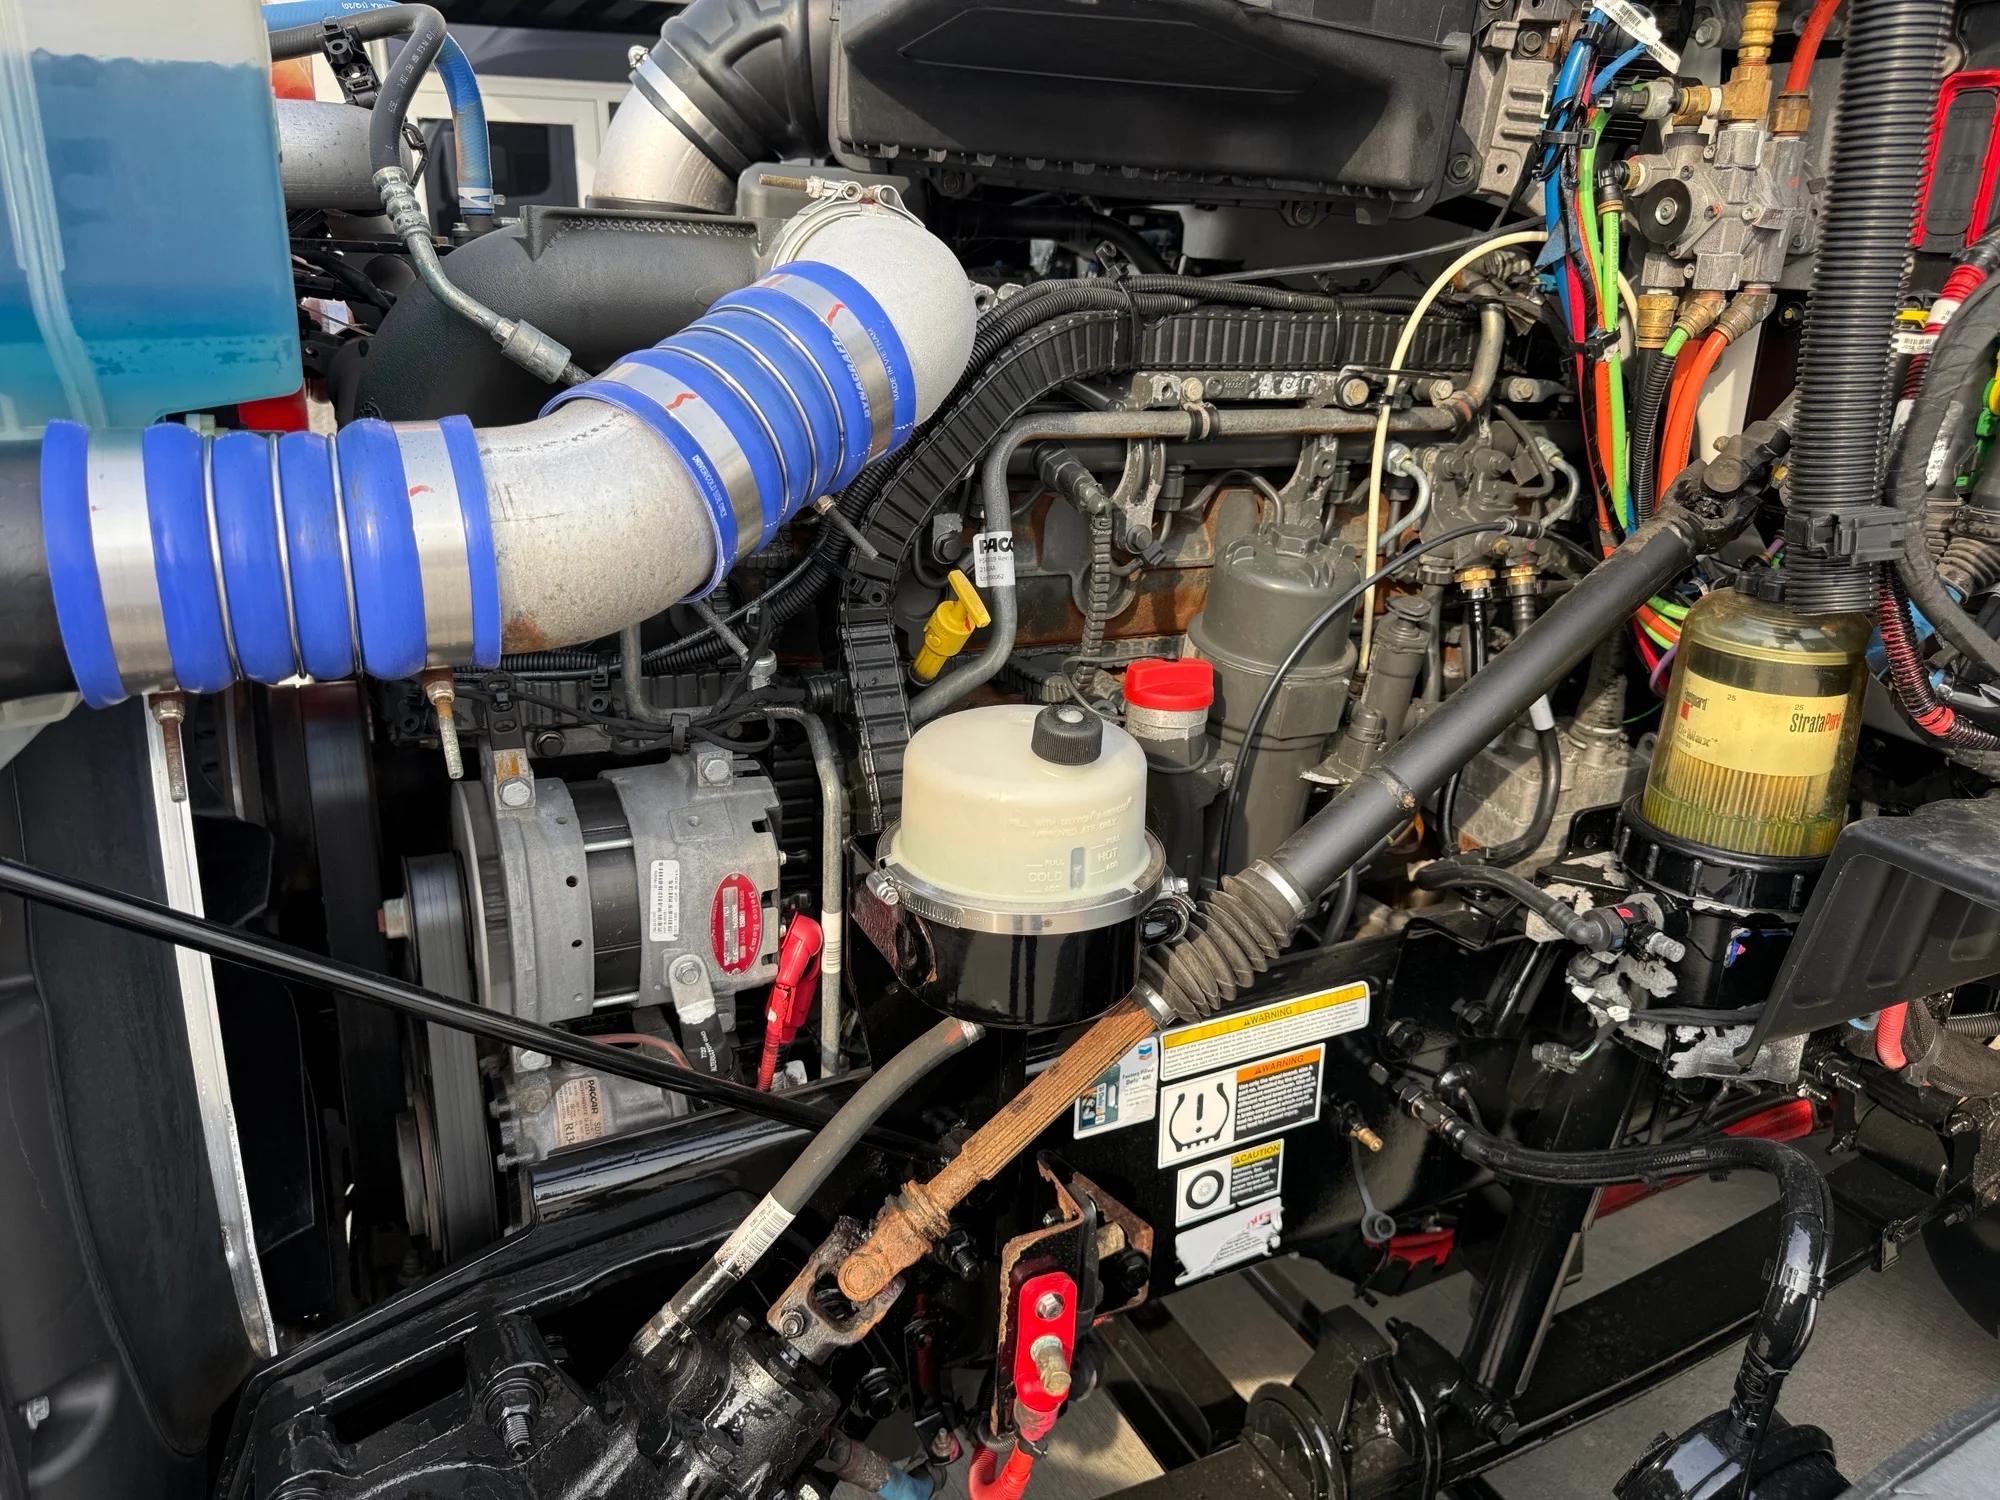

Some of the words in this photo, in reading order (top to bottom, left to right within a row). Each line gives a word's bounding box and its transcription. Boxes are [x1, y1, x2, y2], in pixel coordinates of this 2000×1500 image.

[868, 328, 889, 365] VIETNAM
[891, 377, 901, 401] MADE
[1727, 693, 1737, 702] 25
[1097, 847, 1119, 862] HOT
[1028, 871, 1063, 882] COLD
[749, 891, 758, 920] Delco
[1249, 1006, 1293, 1025] WARNING
[1260, 1054, 1304, 1073] WARNING
[588, 1080, 599, 1114] PACCAR
[1239, 1144, 1280, 1163] CAUTION
